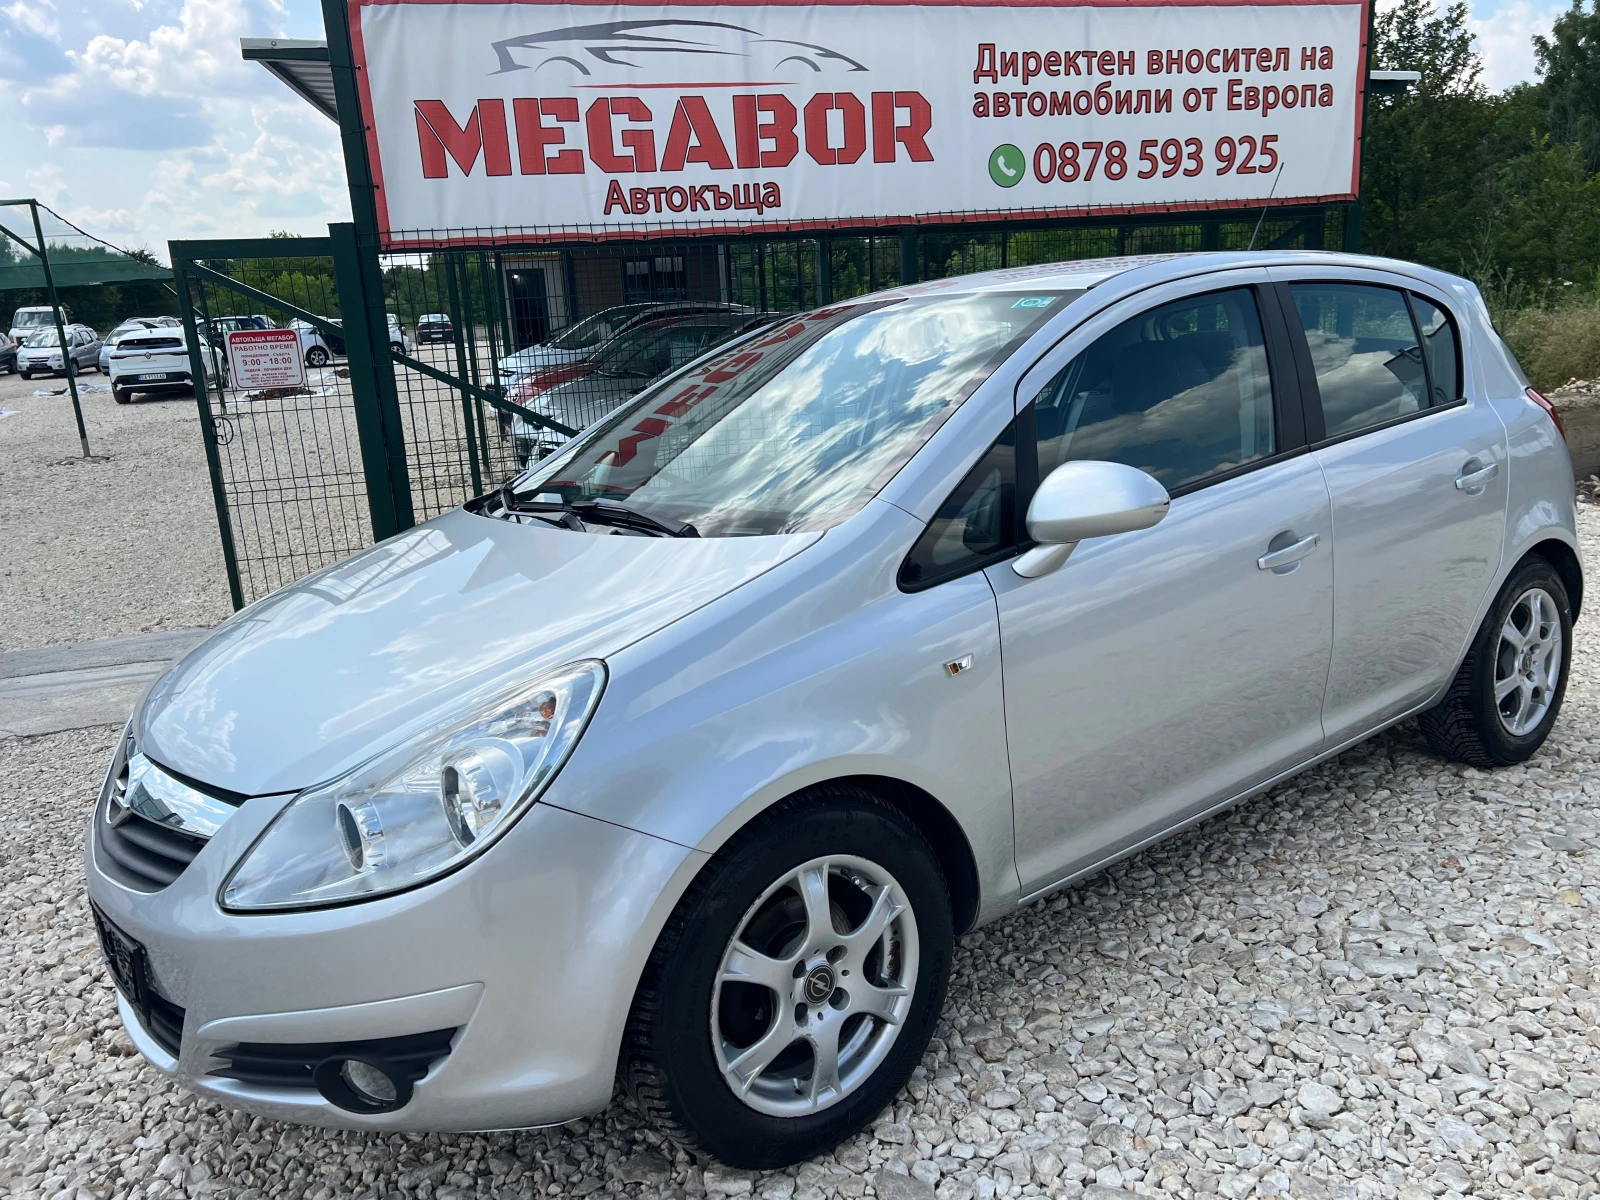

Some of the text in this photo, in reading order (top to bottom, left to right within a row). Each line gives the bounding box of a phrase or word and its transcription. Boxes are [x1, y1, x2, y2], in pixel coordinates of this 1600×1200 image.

[974, 43, 1333, 86] Директен вносител на
[973, 79, 1333, 118] автомобили от Европа
[413, 91, 934, 179] MEGABOR
[1033, 135, 1279, 184] 0878 593 925
[604, 180, 781, 215] Автокъща
[242, 358, 261, 367] 9:00
[268, 357, 292, 365] 18:00
